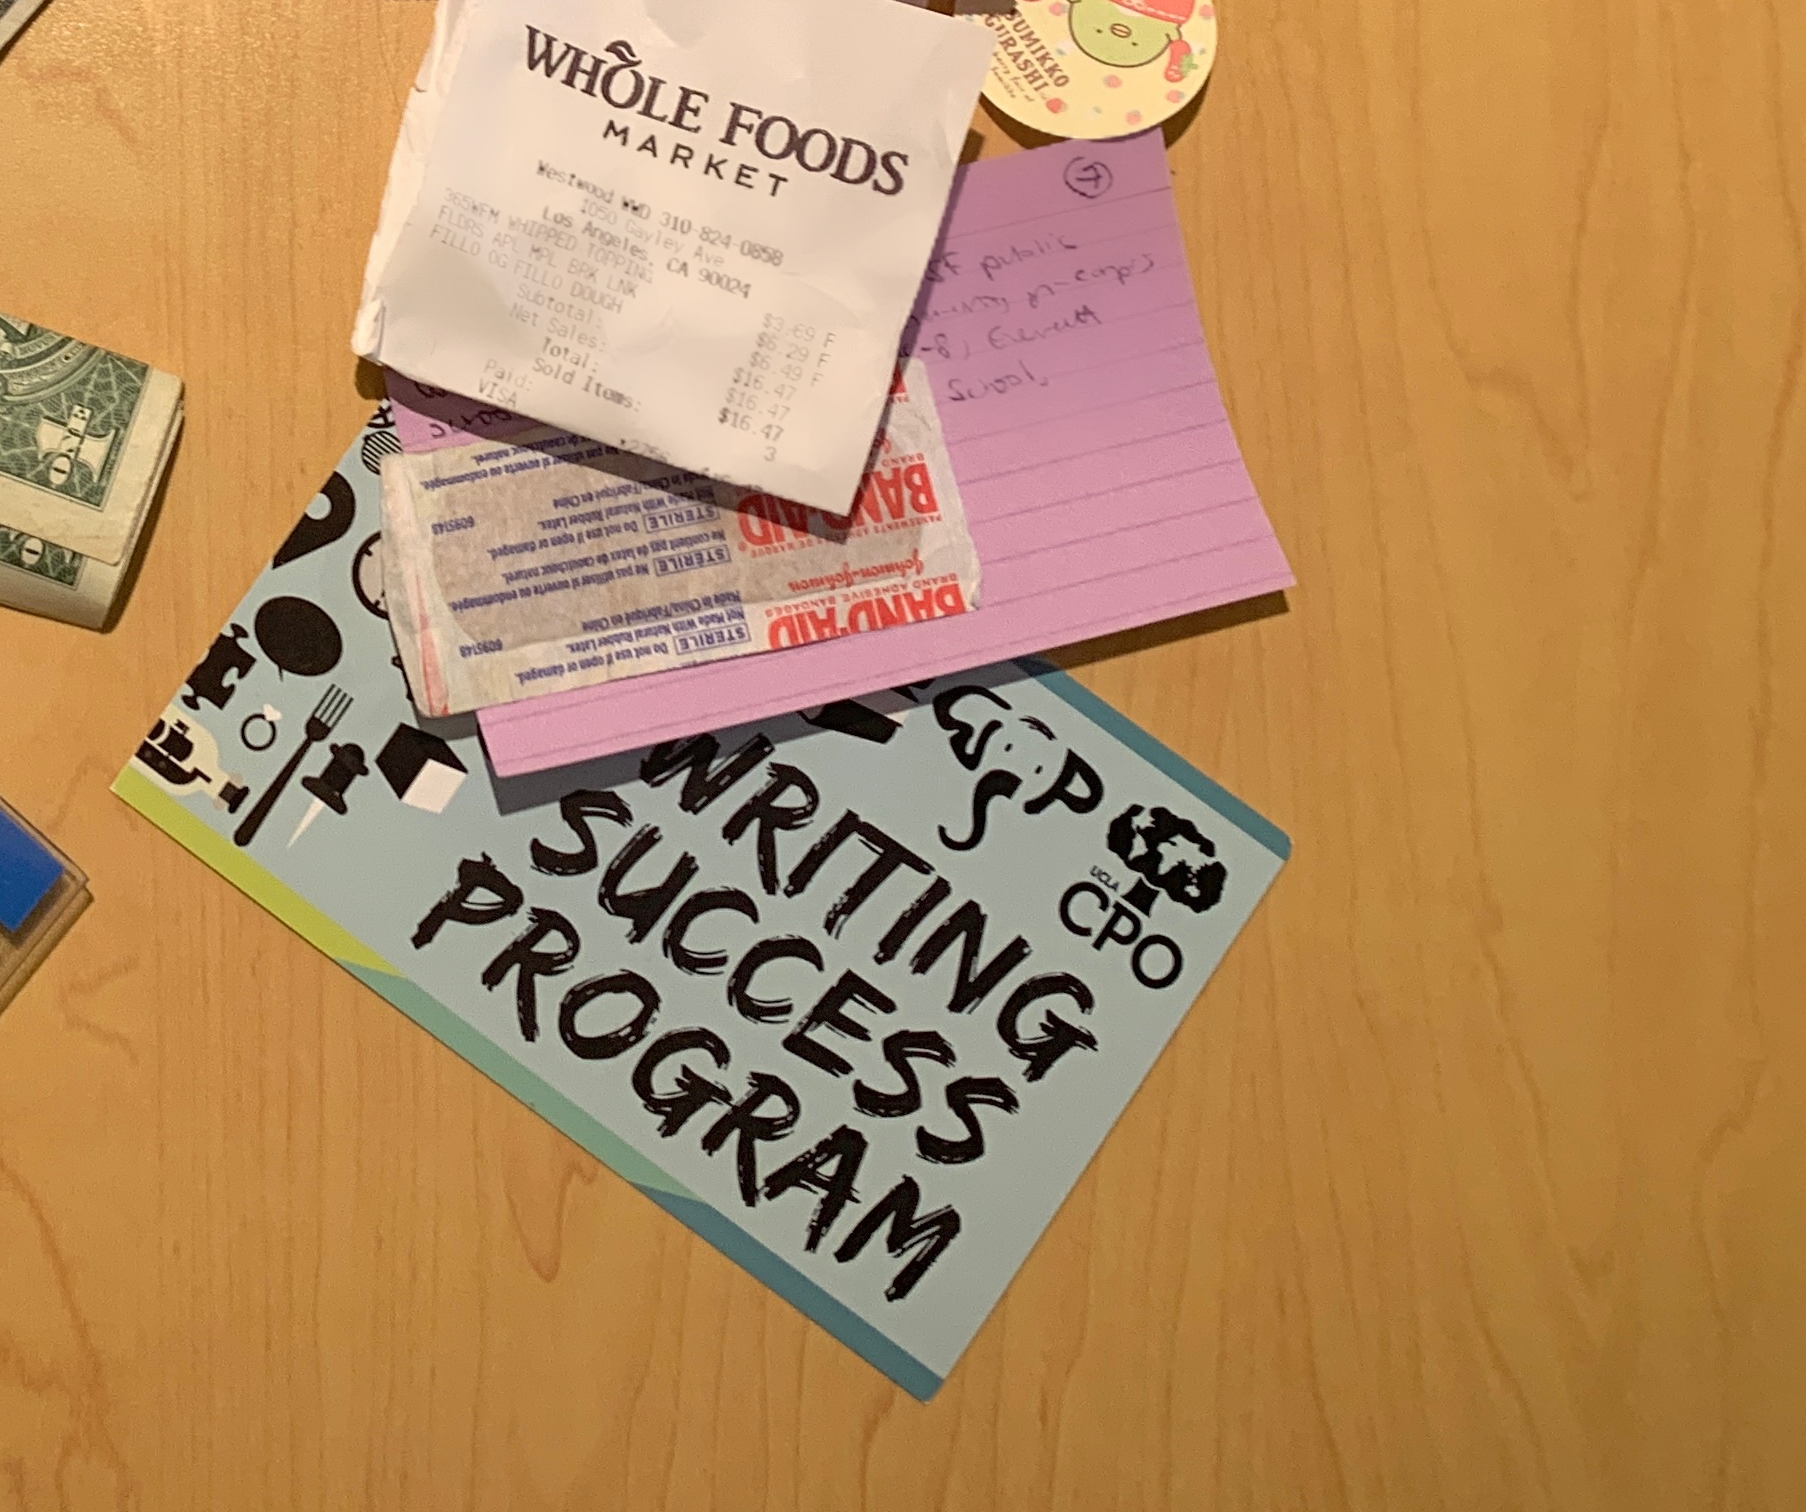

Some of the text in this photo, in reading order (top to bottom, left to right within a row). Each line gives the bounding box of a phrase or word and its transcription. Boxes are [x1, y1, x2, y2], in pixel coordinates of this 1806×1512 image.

[524, 23, 910, 196] WHOLE FOODS
[602, 120, 789, 198] MARKET
[536, 160, 615, 204] Westwood
[580, 198, 725, 266] 1050 Gayley Ave
[542, 205, 573, 228] Los
[666, 257, 689, 277] CA
[697, 268, 752, 299] 90024
[509, 215, 577, 251] WHIPPED
[586, 243, 654, 284] TOPPING
[822, 332, 836, 348] F
[429, 224, 481, 257] FILLO
[514, 259, 563, 291] FILLO
[570, 282, 623, 314] DOUGH
[809, 372, 825, 387] F
[491, 230, 521, 253] APL
[816, 353, 831, 368] F
[516, 283, 797, 399] Subtotal: $16.47
[509, 302, 791, 420] Net Sales: $16.47
[484, 358, 534, 392] Paid:
[478, 377, 518, 408] VISA
[542, 336, 785, 443] Total: $16.47
[532, 357, 778, 462] Sold Items: 3
[568, 509, 603, 527] Rubber
[604, 501, 641, 519] Natural
[647, 503, 715, 529] STERILE
[549, 531, 575, 547] open
[585, 527, 603, 540] use
[605, 523, 622, 537] not
[623, 519, 638, 534] Do
[697, 611, 725, 628] Made
[725, 606, 744, 623] Not
[763, 595, 836, 618] BANDAGES
[581, 616, 610, 634] Chine
[633, 623, 671, 642] Natural
[671, 617, 697, 634] With
[677, 625, 746, 650] STERILE
[596, 630, 633, 649] Rubber
[633, 645, 651, 659] not
[652, 641, 668, 656] Do
[578, 653, 604, 670] open
[614, 648, 633, 661] use
[1089, 865, 1122, 892] UCLA
[639, 731, 1100, 1082] WRITING
[1059, 881, 1183, 989] CPO
[531, 788, 1021, 1165] SUCCESS
[410, 853, 962, 1301] PROGRAM
